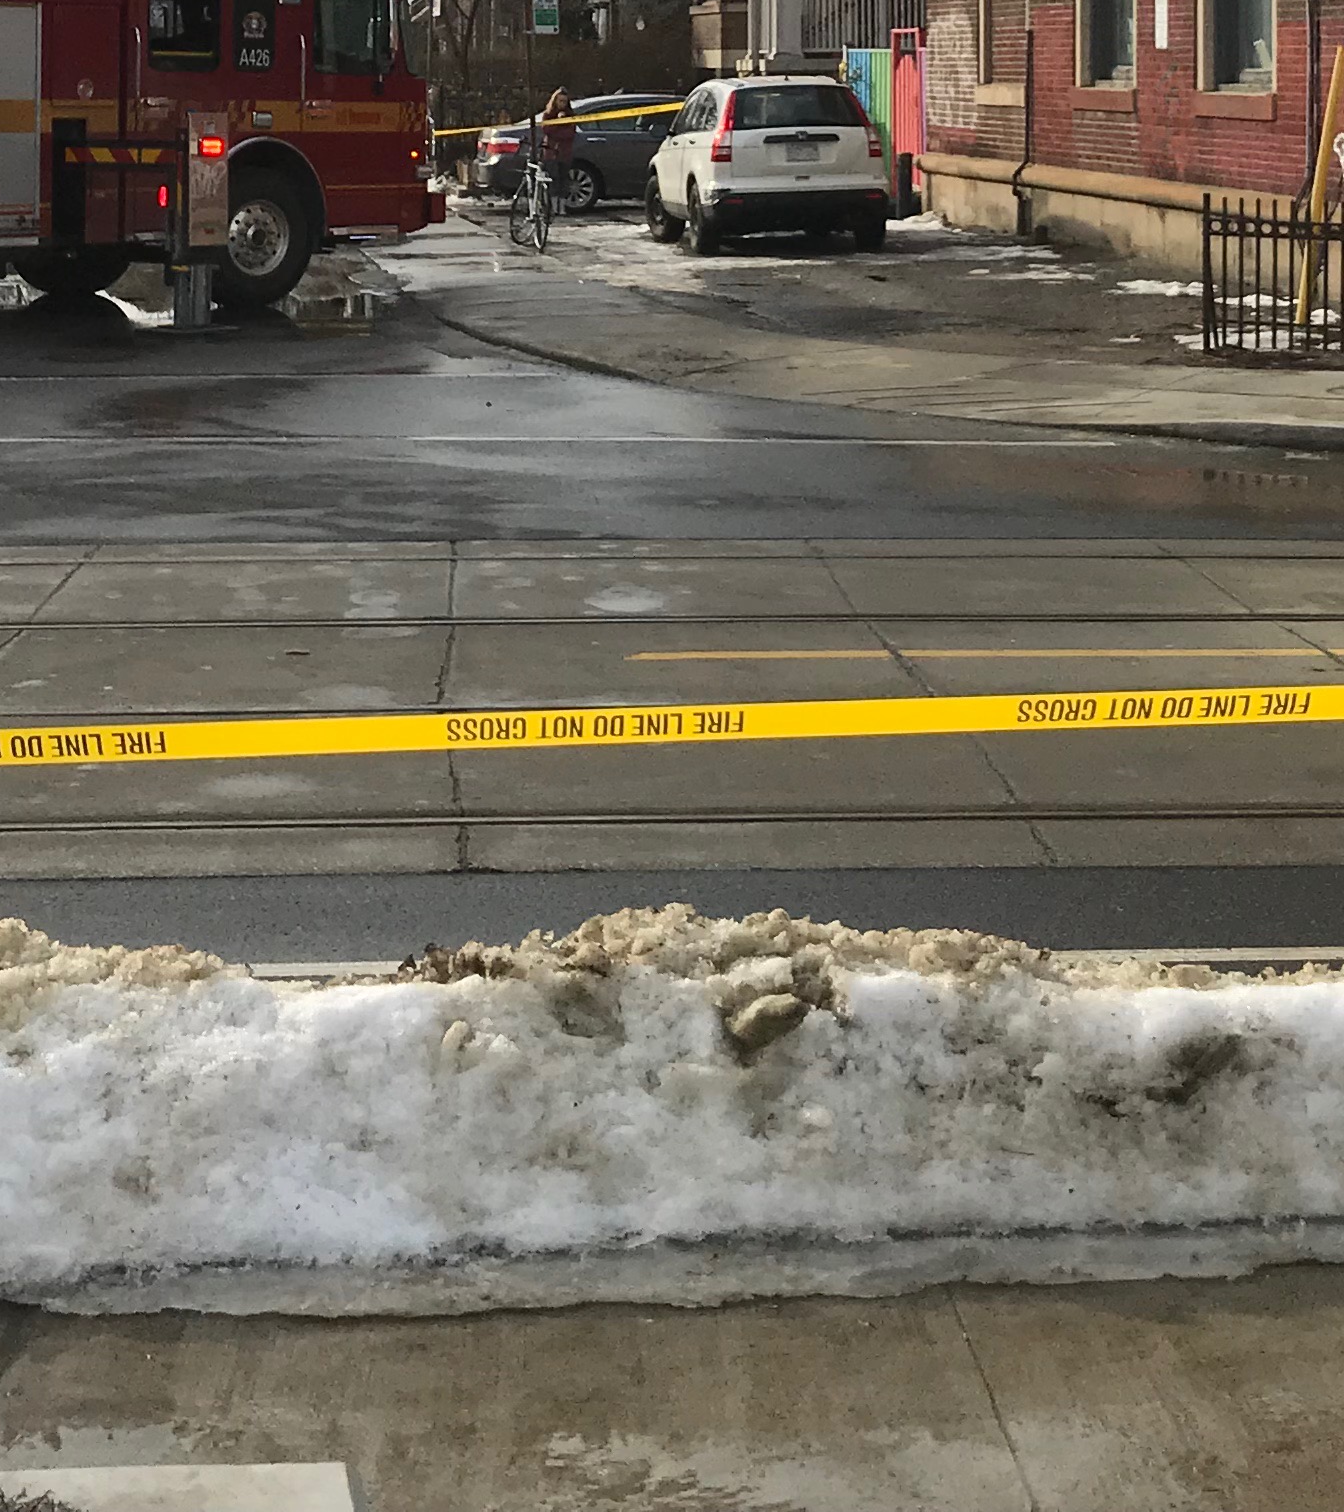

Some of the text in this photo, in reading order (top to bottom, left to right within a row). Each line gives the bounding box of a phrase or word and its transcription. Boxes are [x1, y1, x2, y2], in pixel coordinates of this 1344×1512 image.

[239, 48, 270, 67] A426
[1016, 692, 1311, 723] FIRE LINE DO NOT CROSS
[446, 711, 745, 742] FIRE LINE DO NOT CROSS
[10, 735, 45, 759] DO
[48, 733, 104, 758] LINE
[114, 731, 167, 754] FIRE
